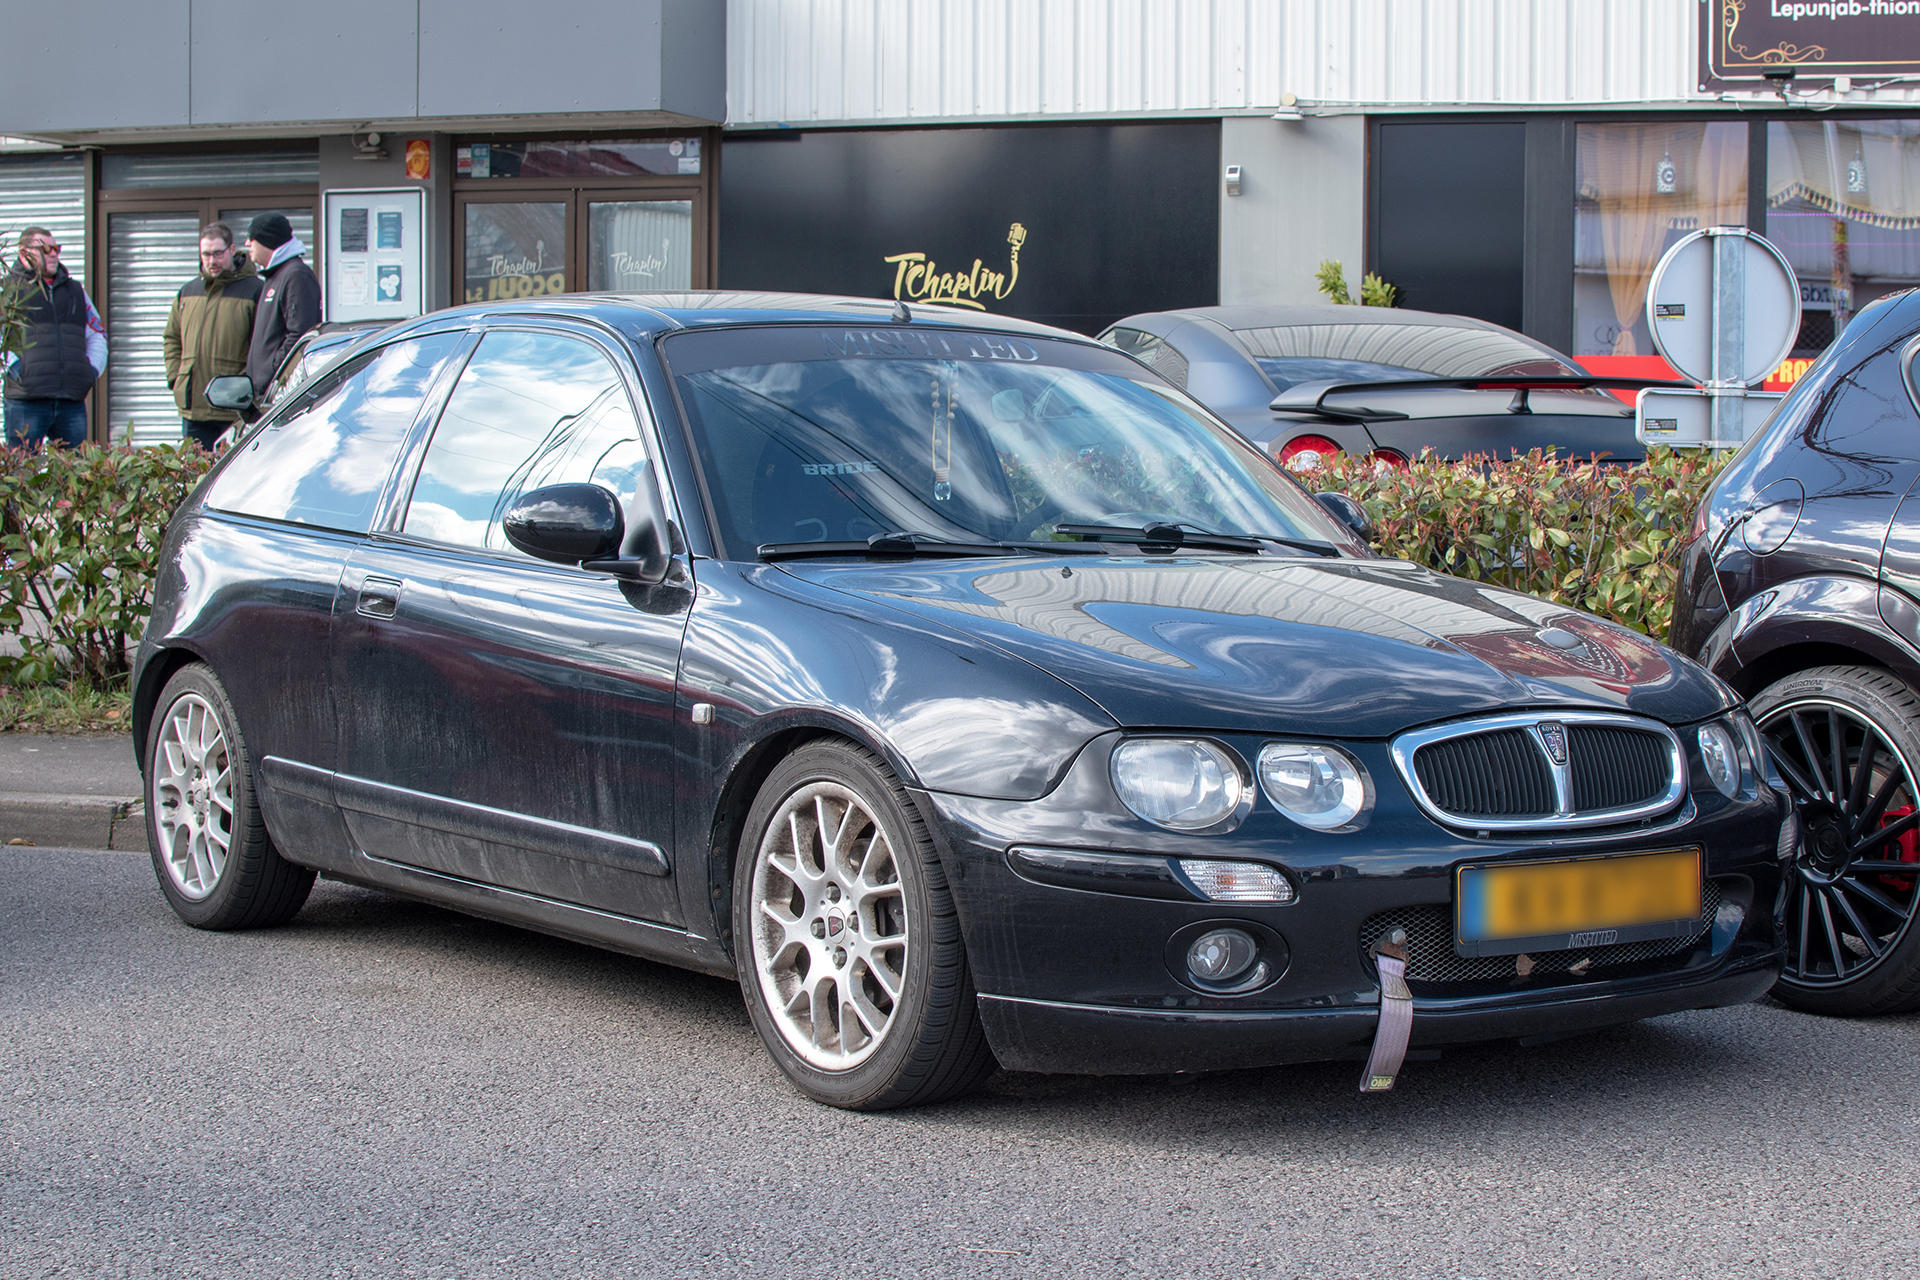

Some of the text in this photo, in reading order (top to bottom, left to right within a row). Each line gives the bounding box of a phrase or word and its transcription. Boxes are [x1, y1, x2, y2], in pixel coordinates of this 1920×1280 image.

[817, 330, 1040, 363] MISFITTED
[1766, 360, 1815, 383] RO
[1783, 679, 1823, 691] UNIROYAL
[1567, 929, 1618, 949] MISFITTED
[1371, 1078, 1392, 1087] OMP
